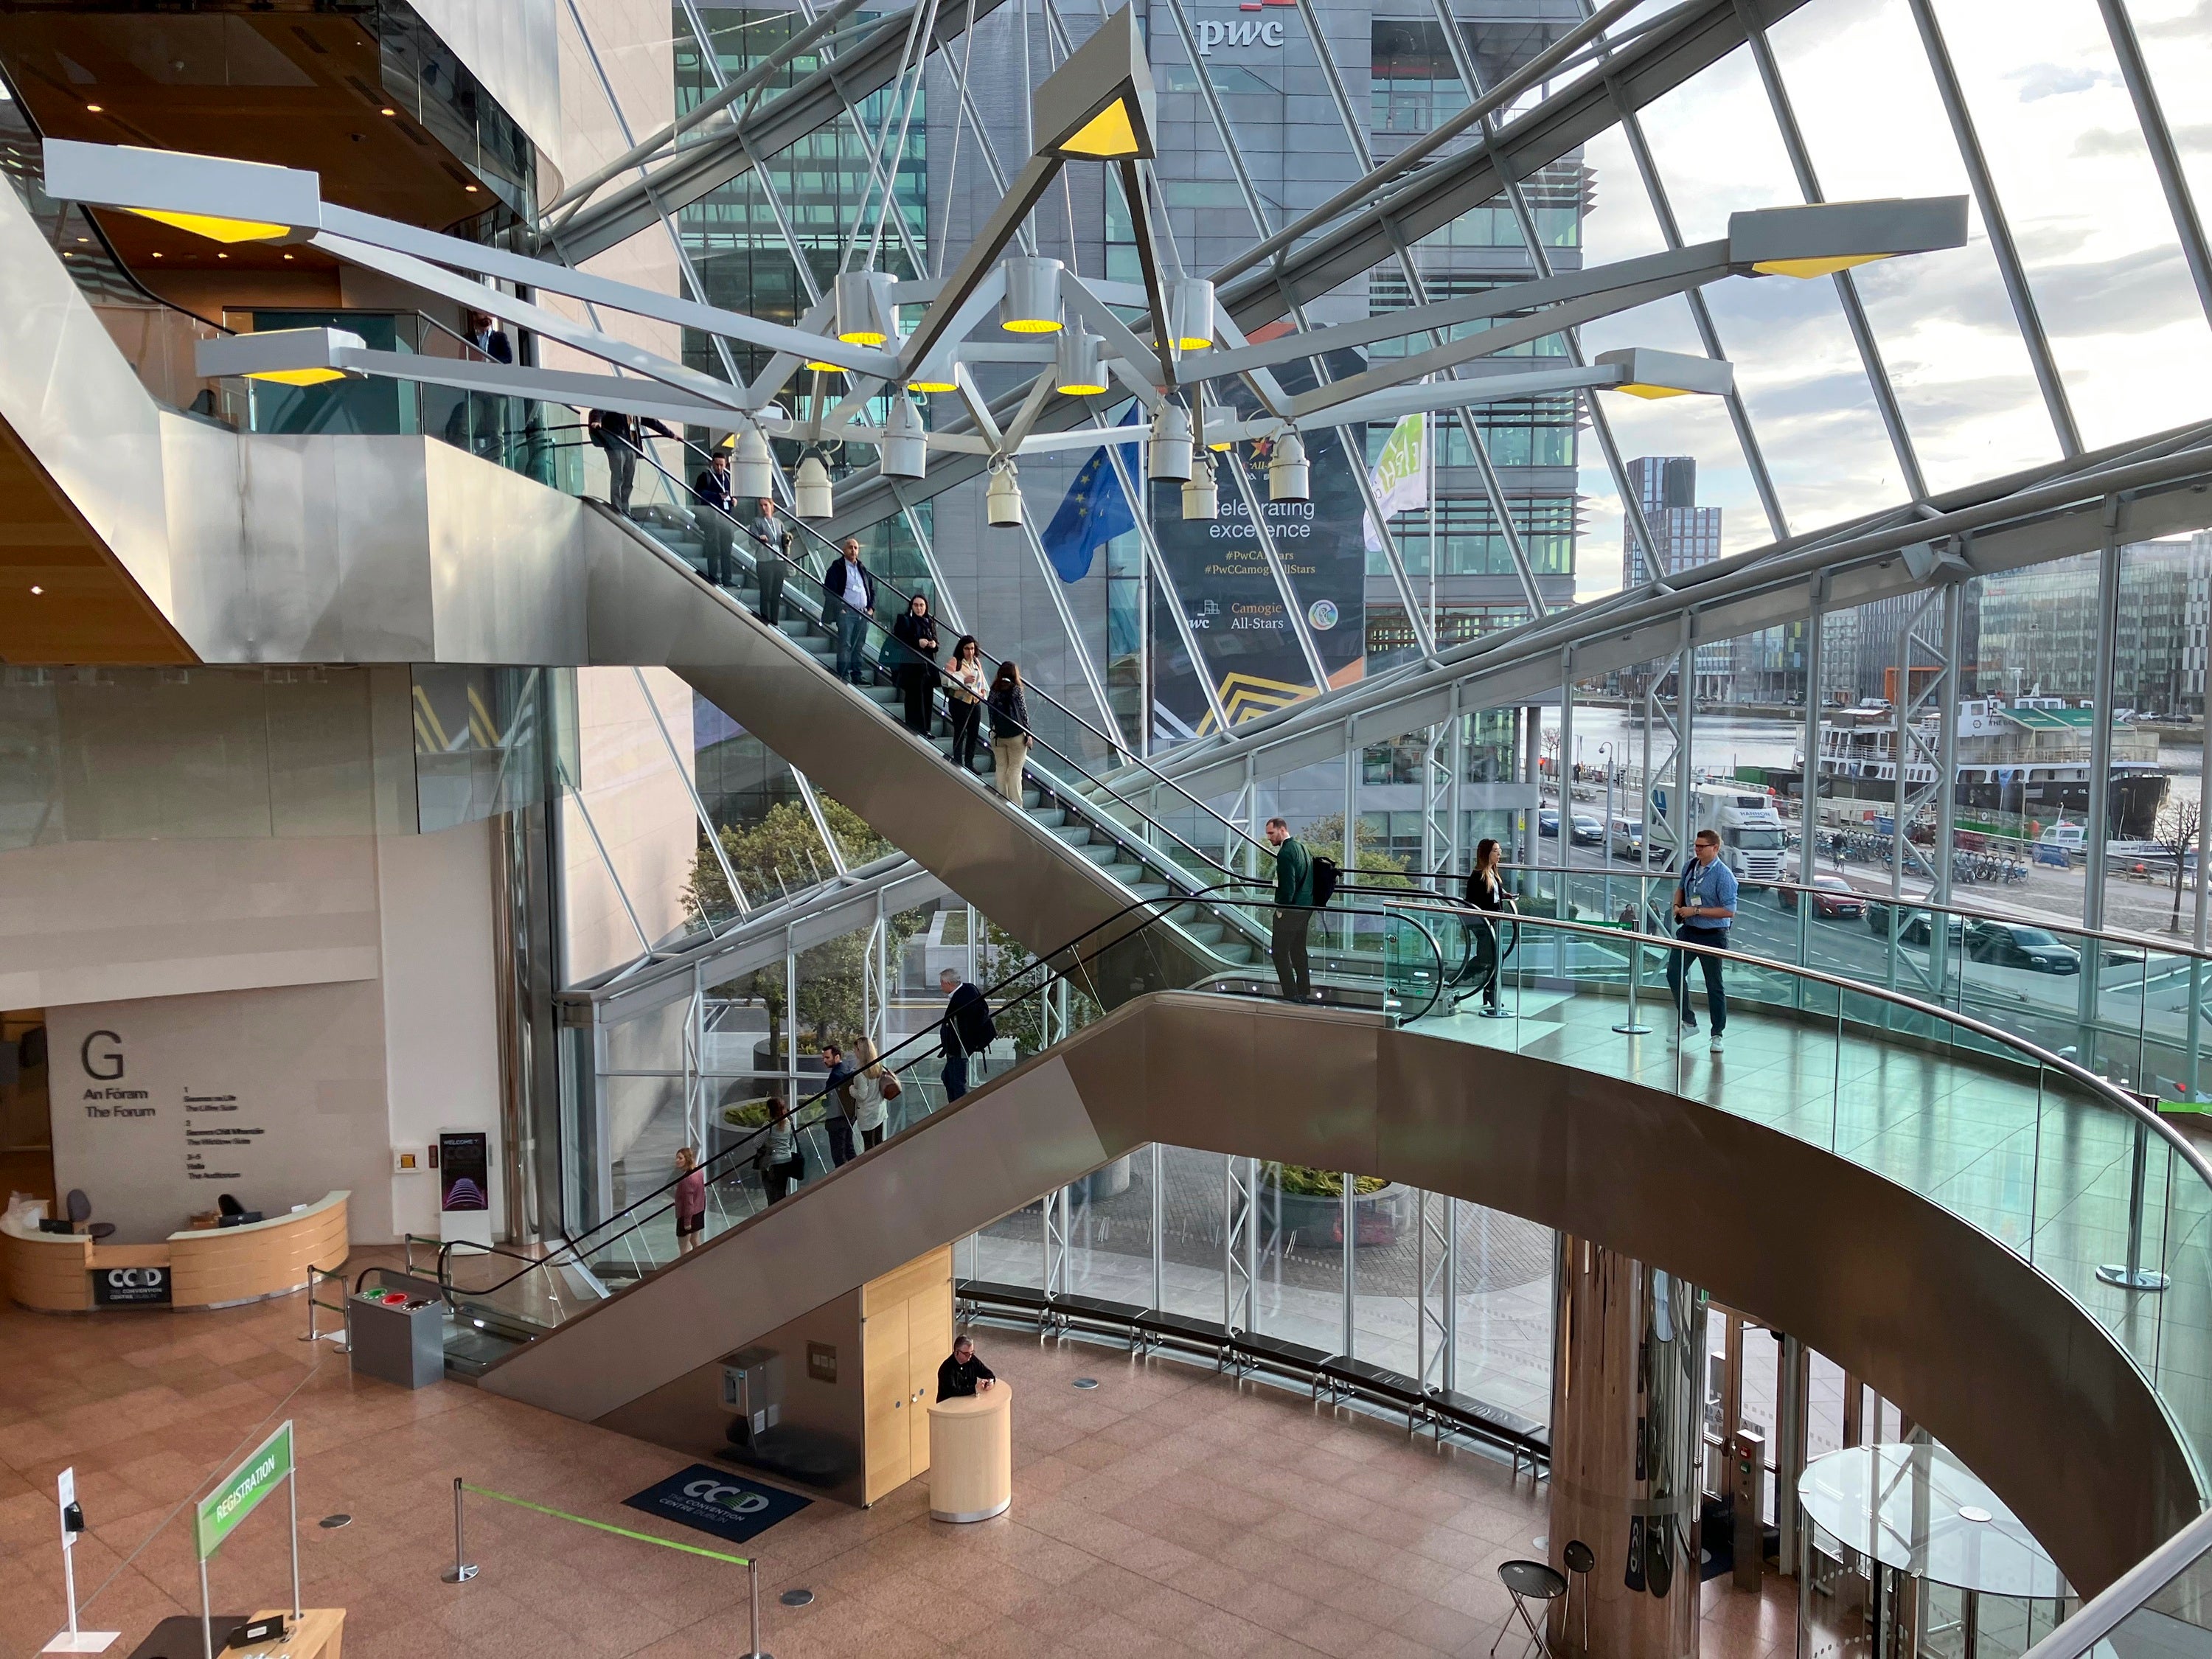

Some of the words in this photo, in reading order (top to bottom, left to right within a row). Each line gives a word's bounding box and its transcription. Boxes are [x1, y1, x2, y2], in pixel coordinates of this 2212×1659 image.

[1197, 20, 1284, 56] pwc
[1217, 499, 1315, 521] elerating
[1209, 524, 1310, 538] exceence
[1231, 602, 1282, 615] Camogie
[1188, 619, 1210, 629] wc
[1231, 618, 1284, 629] All-Stars
[81, 1030, 123, 1080] G
[83, 1088, 102, 1100] An
[85, 1106, 110, 1118] The
[114, 1105, 156, 1117] Forum
[108, 1268, 161, 1287] CCD
[216, 1454, 275, 1523] REGISTRATION
[684, 1480, 769, 1513] CCD
[659, 1498, 695, 1512] CENTRE
[686, 1499, 745, 1521] CONVENTION
